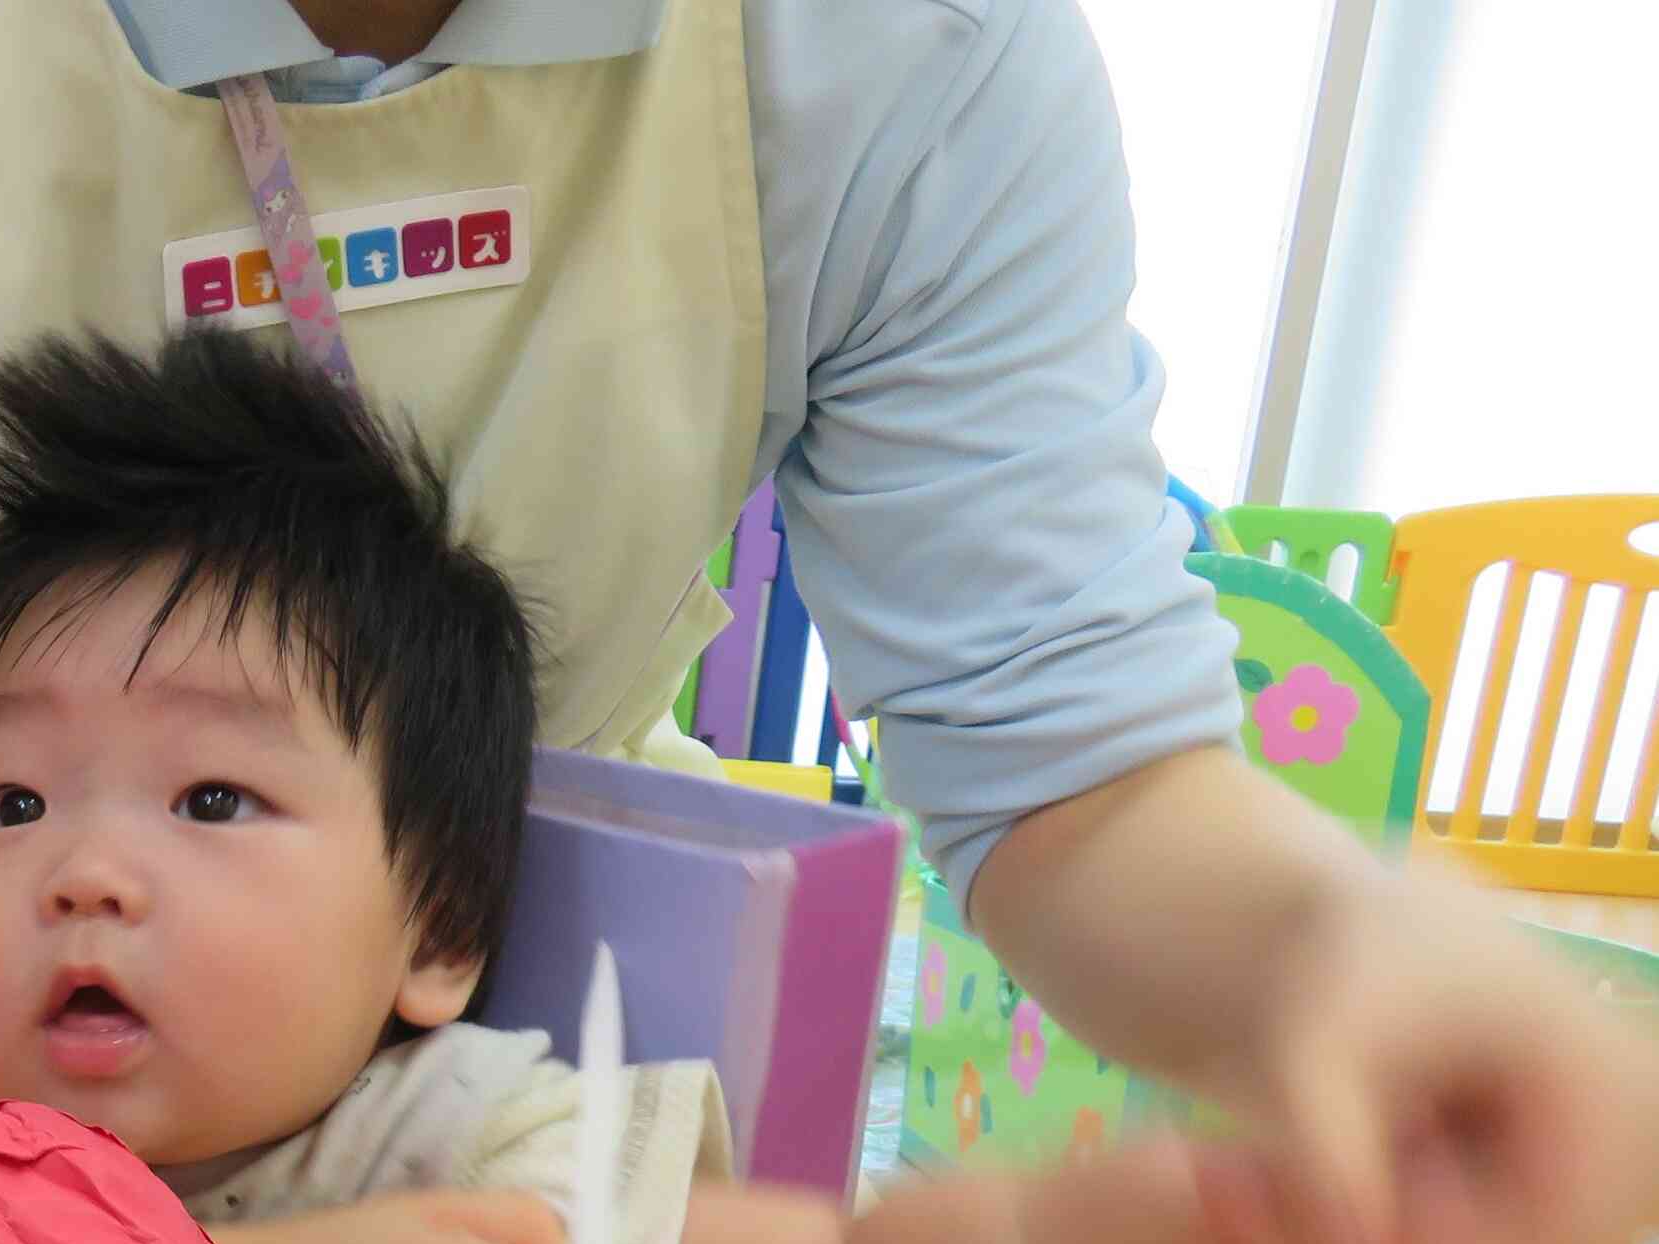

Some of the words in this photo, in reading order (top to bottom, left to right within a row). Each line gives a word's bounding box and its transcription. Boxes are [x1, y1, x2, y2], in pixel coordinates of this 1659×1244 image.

[200, 229, 508, 309] ニチキッズ
